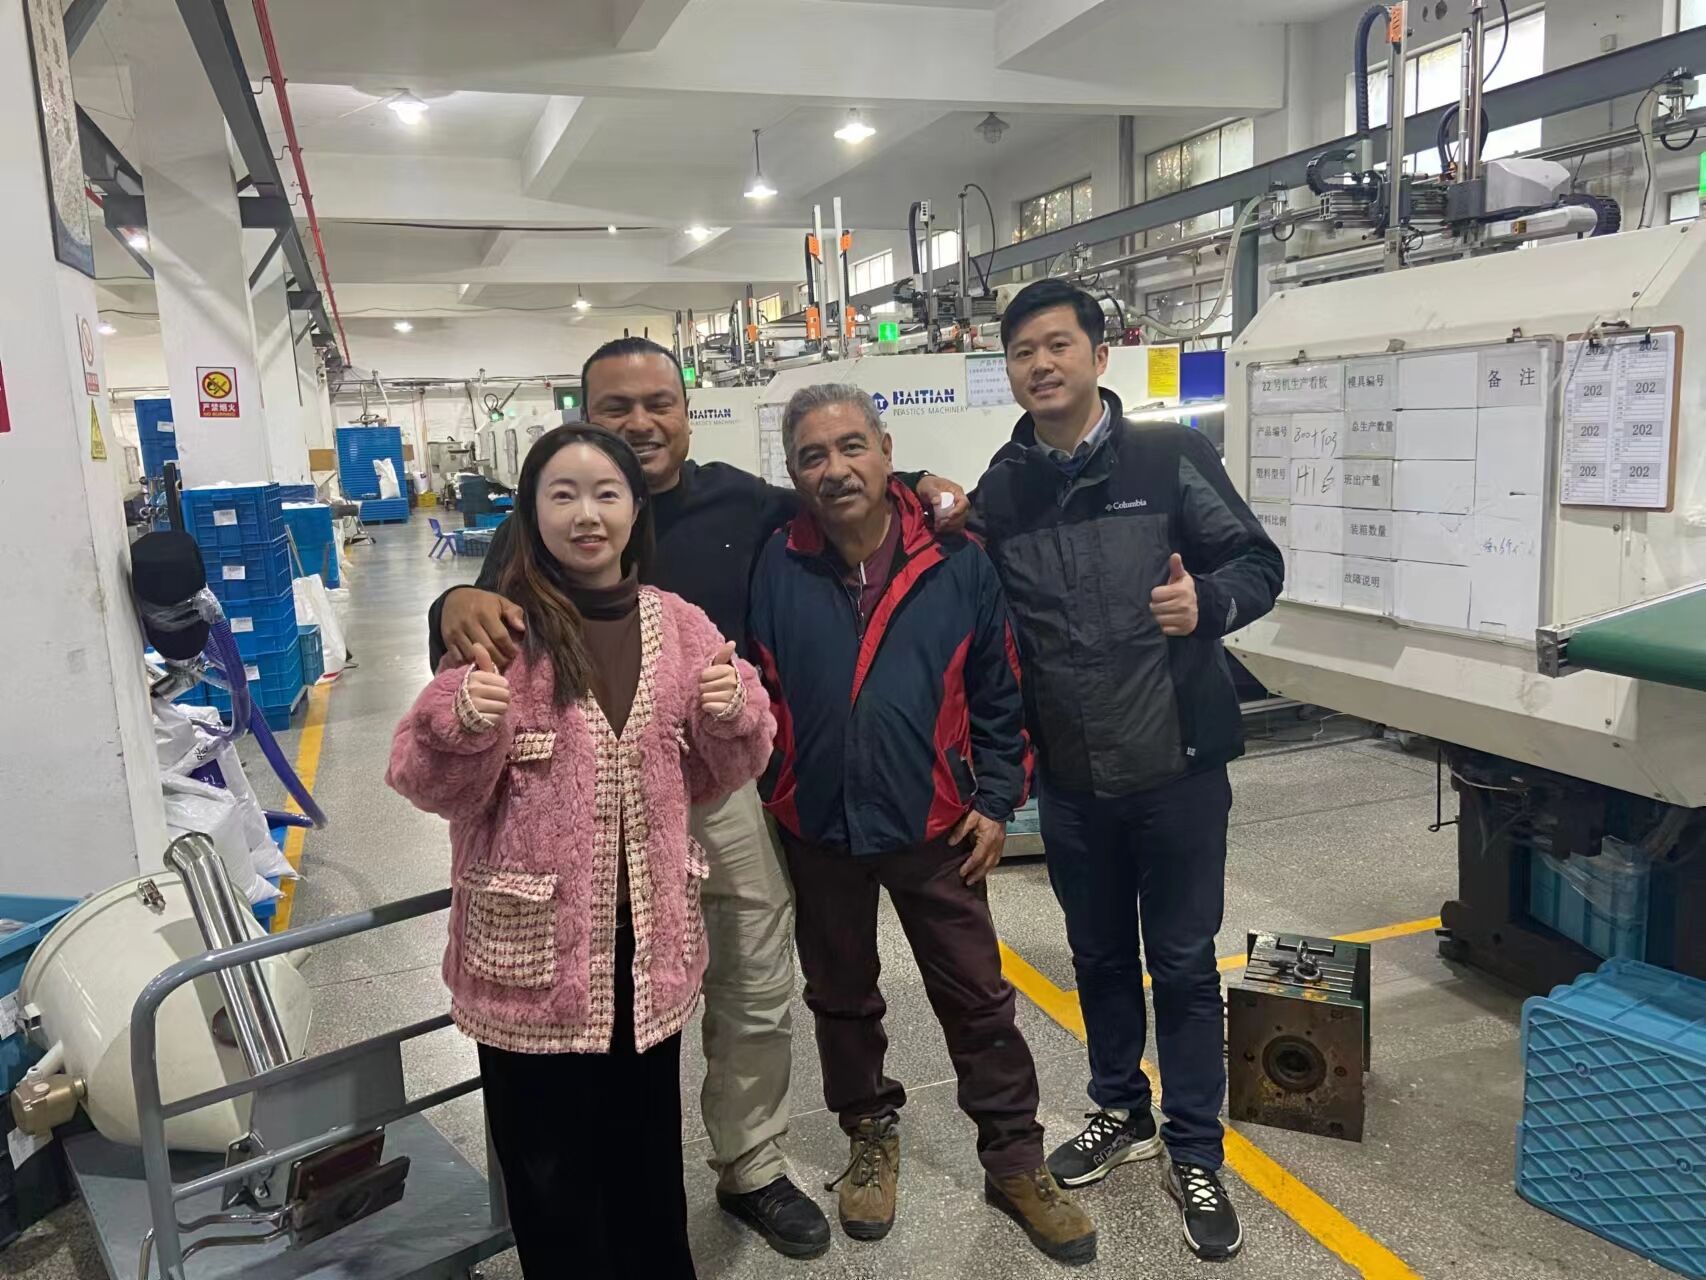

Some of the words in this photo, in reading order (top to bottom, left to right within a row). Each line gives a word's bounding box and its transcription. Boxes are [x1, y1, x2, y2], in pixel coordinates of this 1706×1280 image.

[1348, 375, 1384, 388] 模具编号
[1583, 385, 1602, 396] 202
[1635, 382, 1656, 393] 202
[893, 388, 954, 405] HAITIAN
[928, 403, 969, 415] MACHINERY
[1256, 425, 1288, 437] 产品编号
[1351, 421, 1394, 432] 总生产数量
[1580, 425, 1599, 436] 202
[1632, 424, 1653, 435] 202
[1256, 468, 1287, 480] 塑料型号
[1579, 466, 1597, 477] 202
[1629, 466, 1650, 477] 202
[1344, 474, 1380, 486] 班出产量
[1113, 499, 1147, 510] Columbia
[1350, 523, 1386, 537] 装箱数量
[1344, 573, 1380, 588] 故障说明
